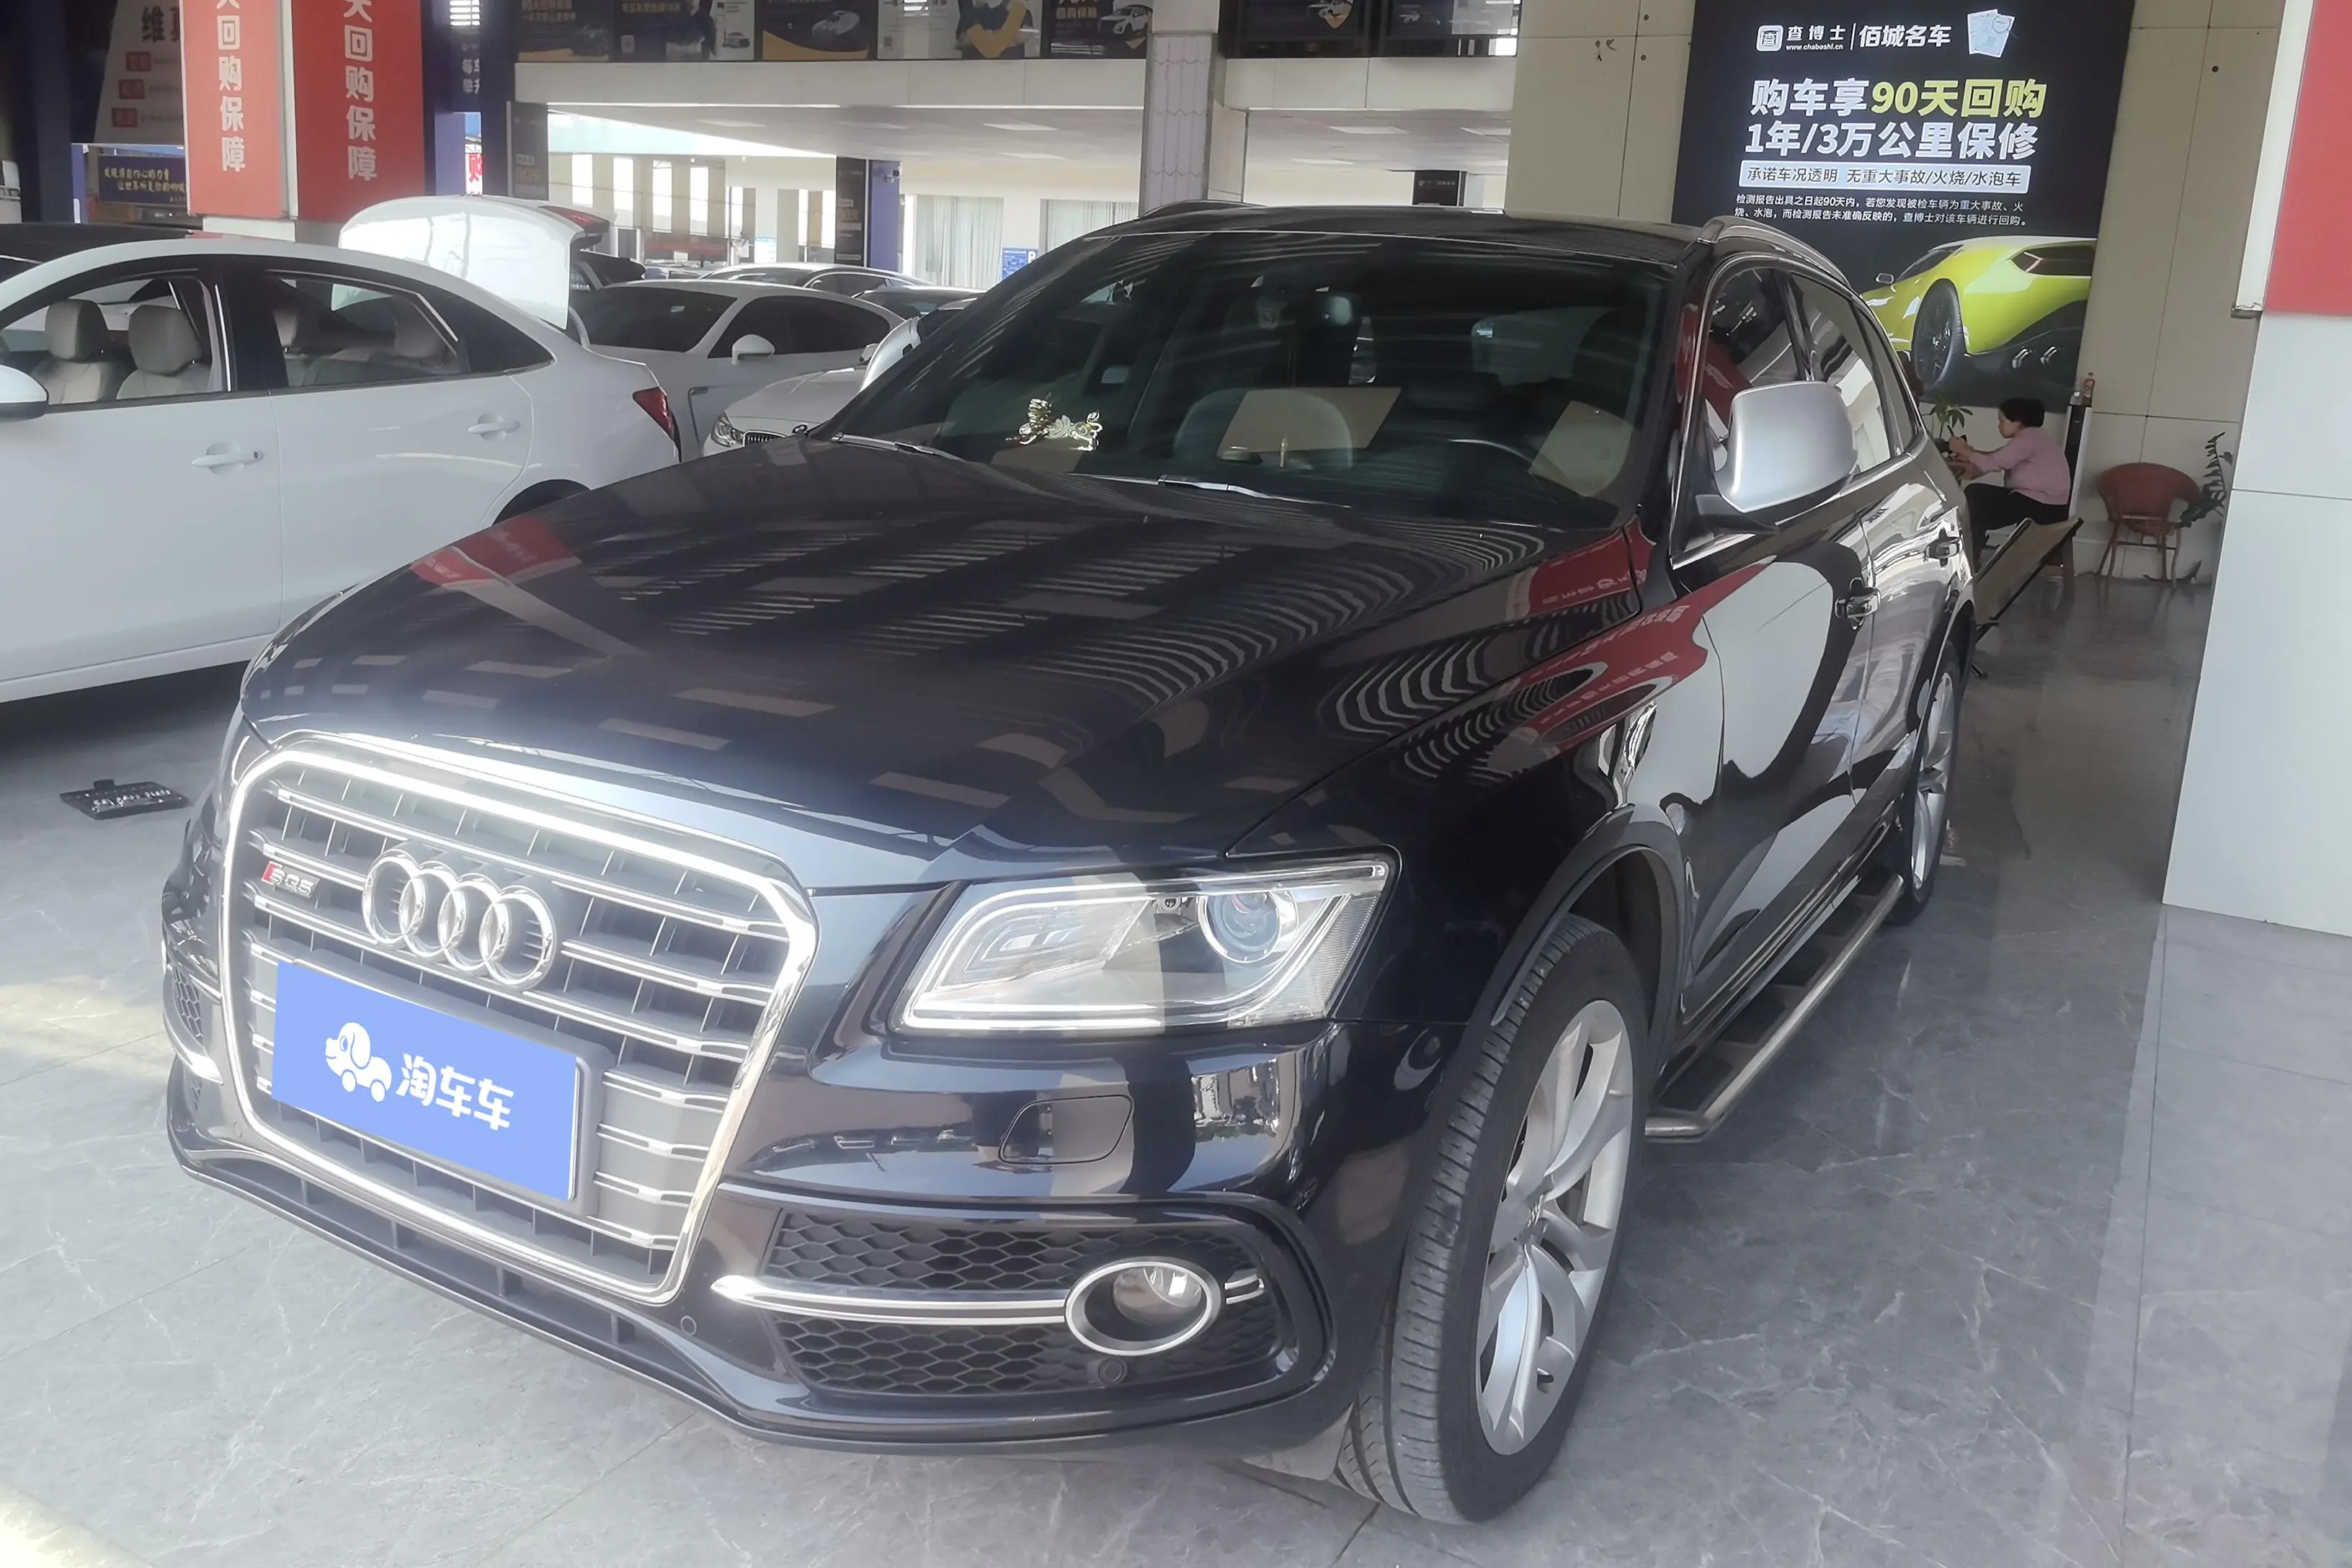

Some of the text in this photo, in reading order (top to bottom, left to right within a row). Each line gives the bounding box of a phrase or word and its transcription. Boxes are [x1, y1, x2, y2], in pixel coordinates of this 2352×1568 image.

[1787, 25, 1951, 48] 查博士 佰城名车
[217, 0, 246, 172] 回购保障
[1750, 77, 2048, 118] 购车享90天回购
[1745, 120, 2039, 161] 1年/3万公里保修
[1747, 166, 2022, 187] 承诺车况透明 无重大事故/火烧/水泡车
[269, 868, 315, 896] SQ5
